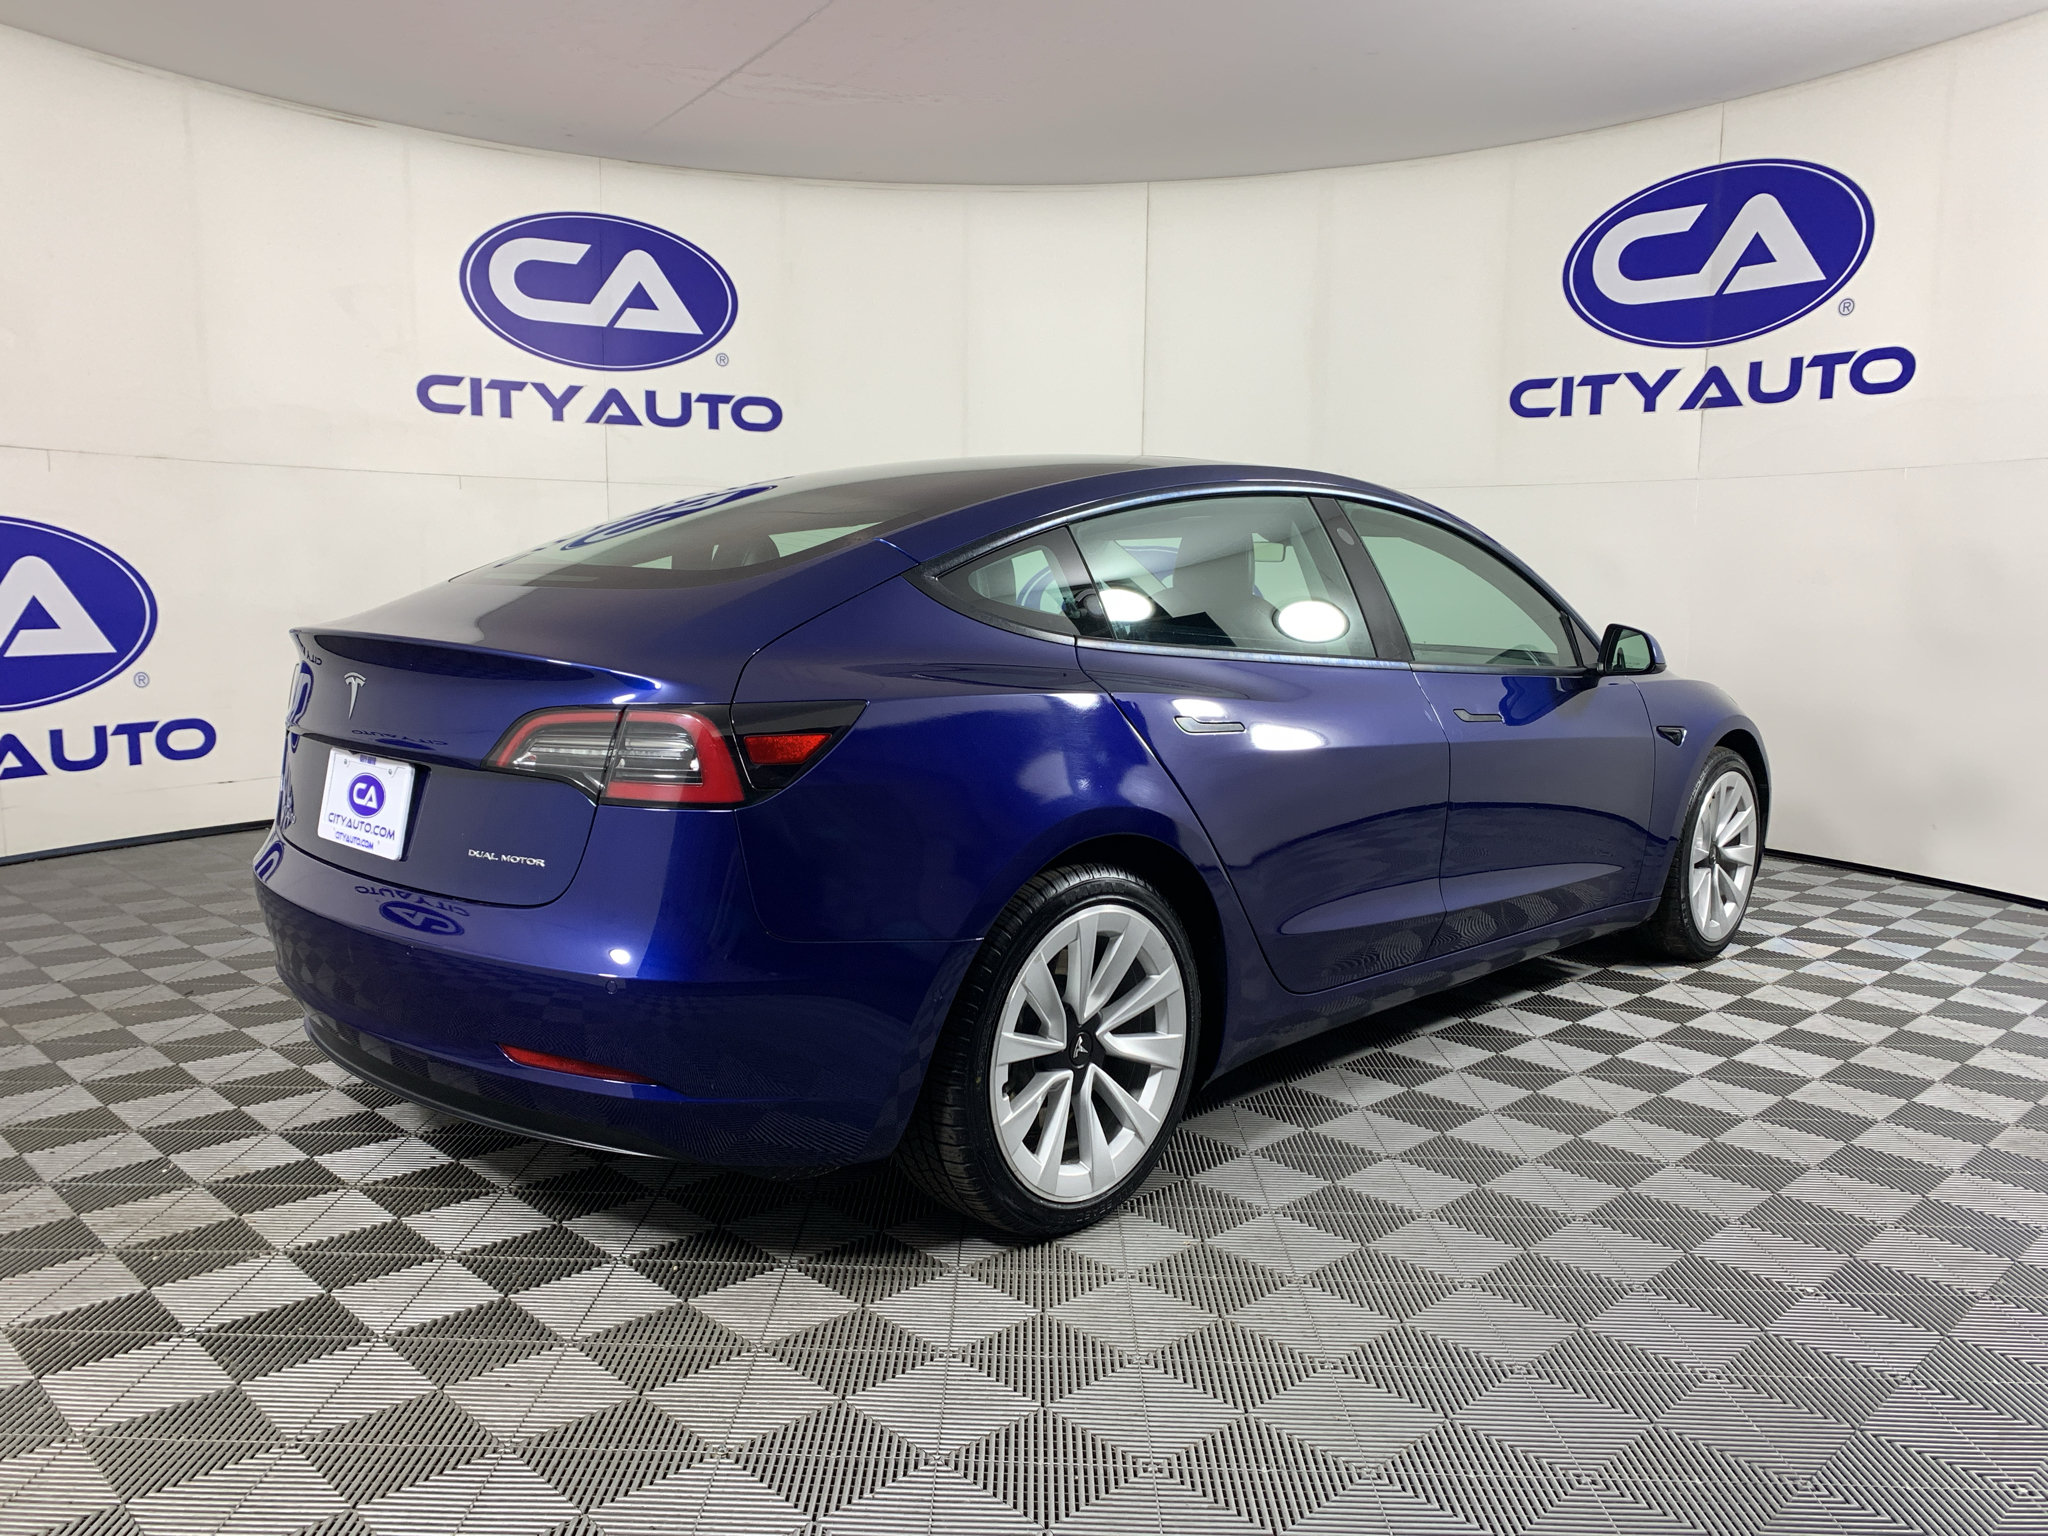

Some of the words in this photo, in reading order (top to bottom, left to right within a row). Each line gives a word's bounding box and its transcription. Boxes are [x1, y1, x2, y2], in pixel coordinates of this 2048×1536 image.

[1592, 192, 1827, 305] CA
[488, 237, 704, 335] CA
[352, 781, 378, 810] CA
[328, 812, 395, 840] CITYAUTO.COM
[468, 849, 499, 861] DUAL
[501, 854, 546, 868] MOTOR
